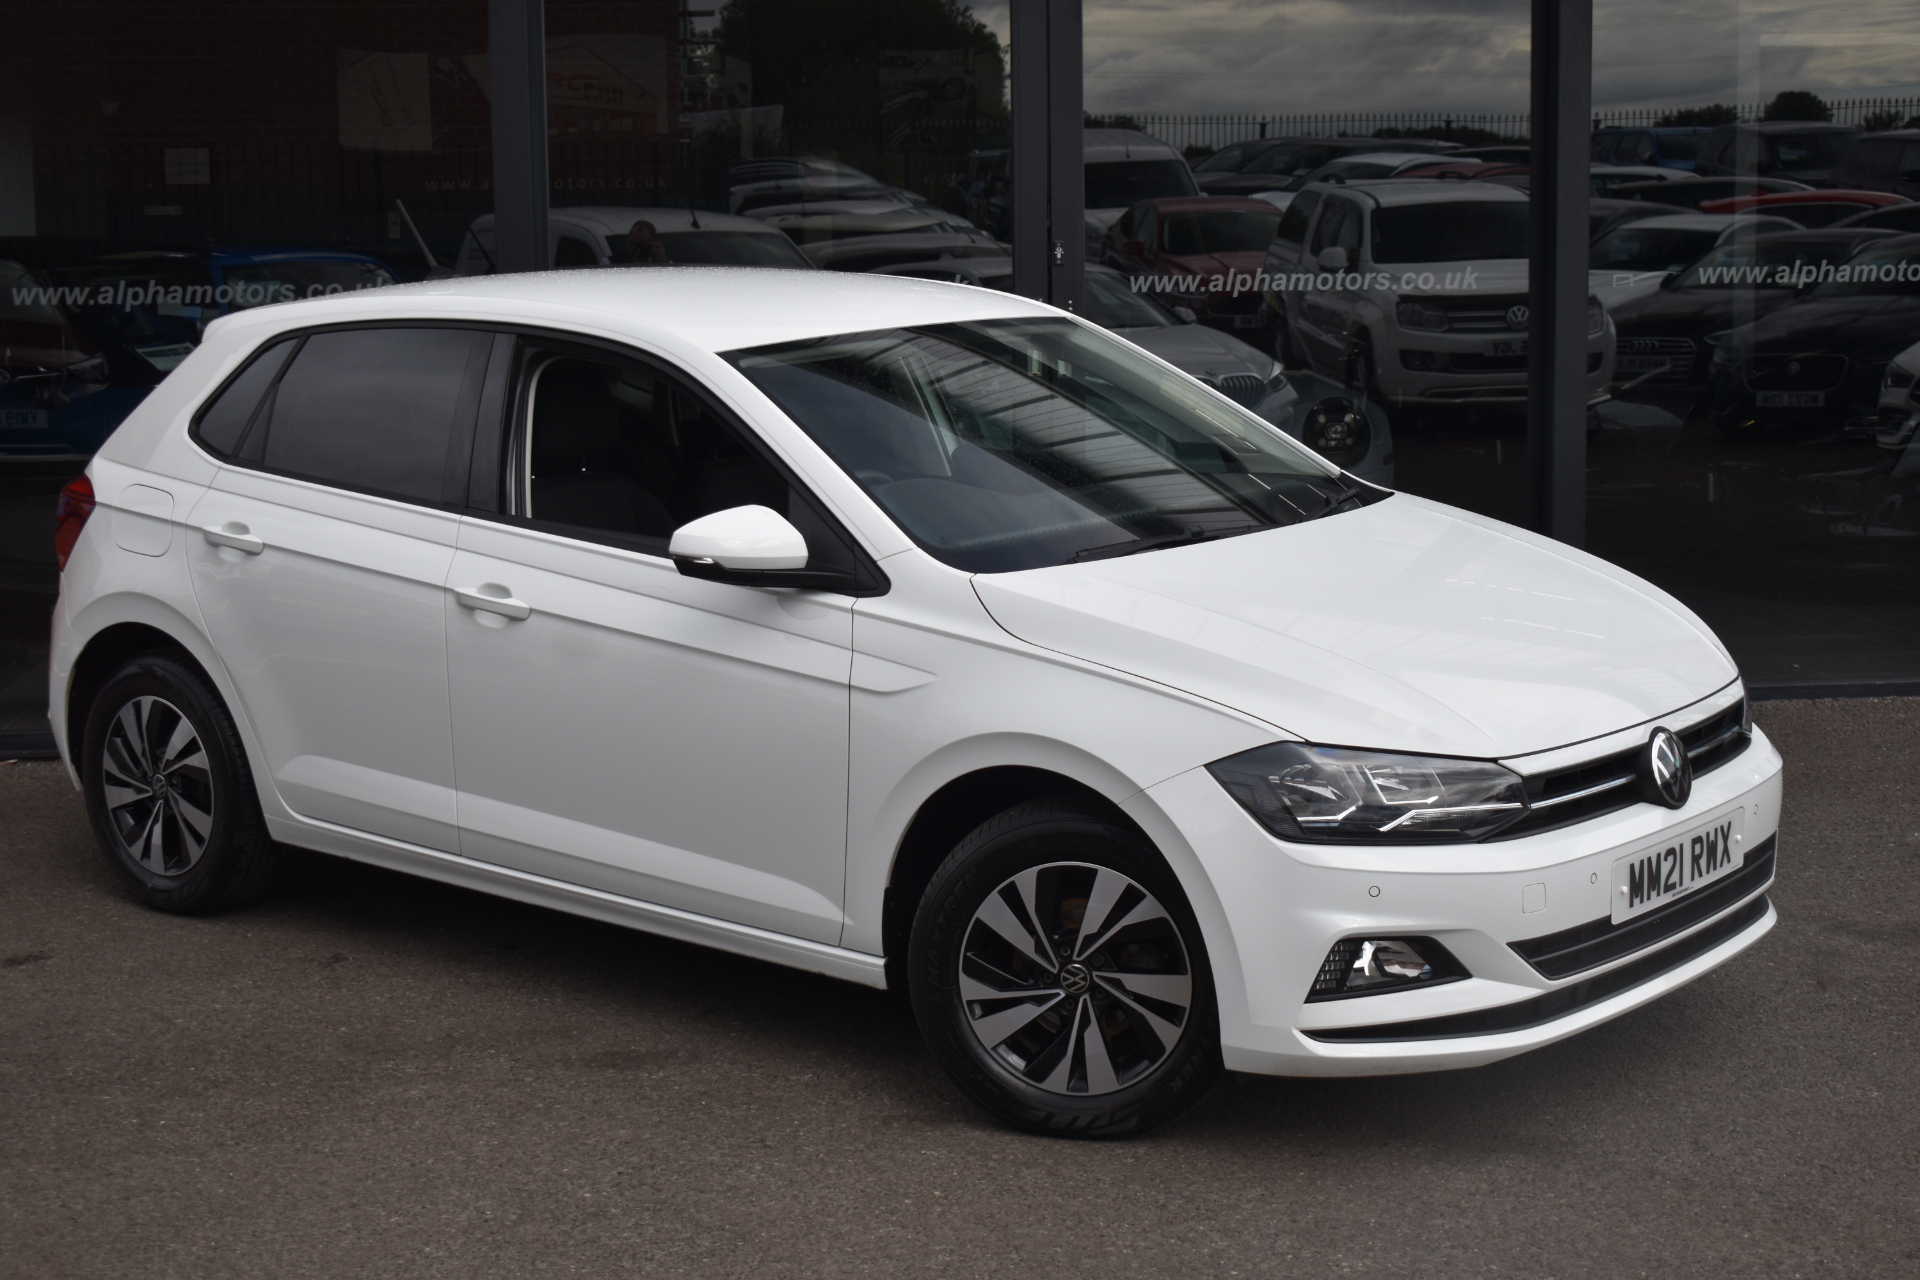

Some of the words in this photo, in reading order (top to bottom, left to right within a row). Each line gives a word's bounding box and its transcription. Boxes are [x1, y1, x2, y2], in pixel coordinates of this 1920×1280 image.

[1129, 265, 1480, 298] www.alphamotors.co.uk
[1629, 842, 1684, 909] MM21
[1690, 820, 1732, 882] RWX
